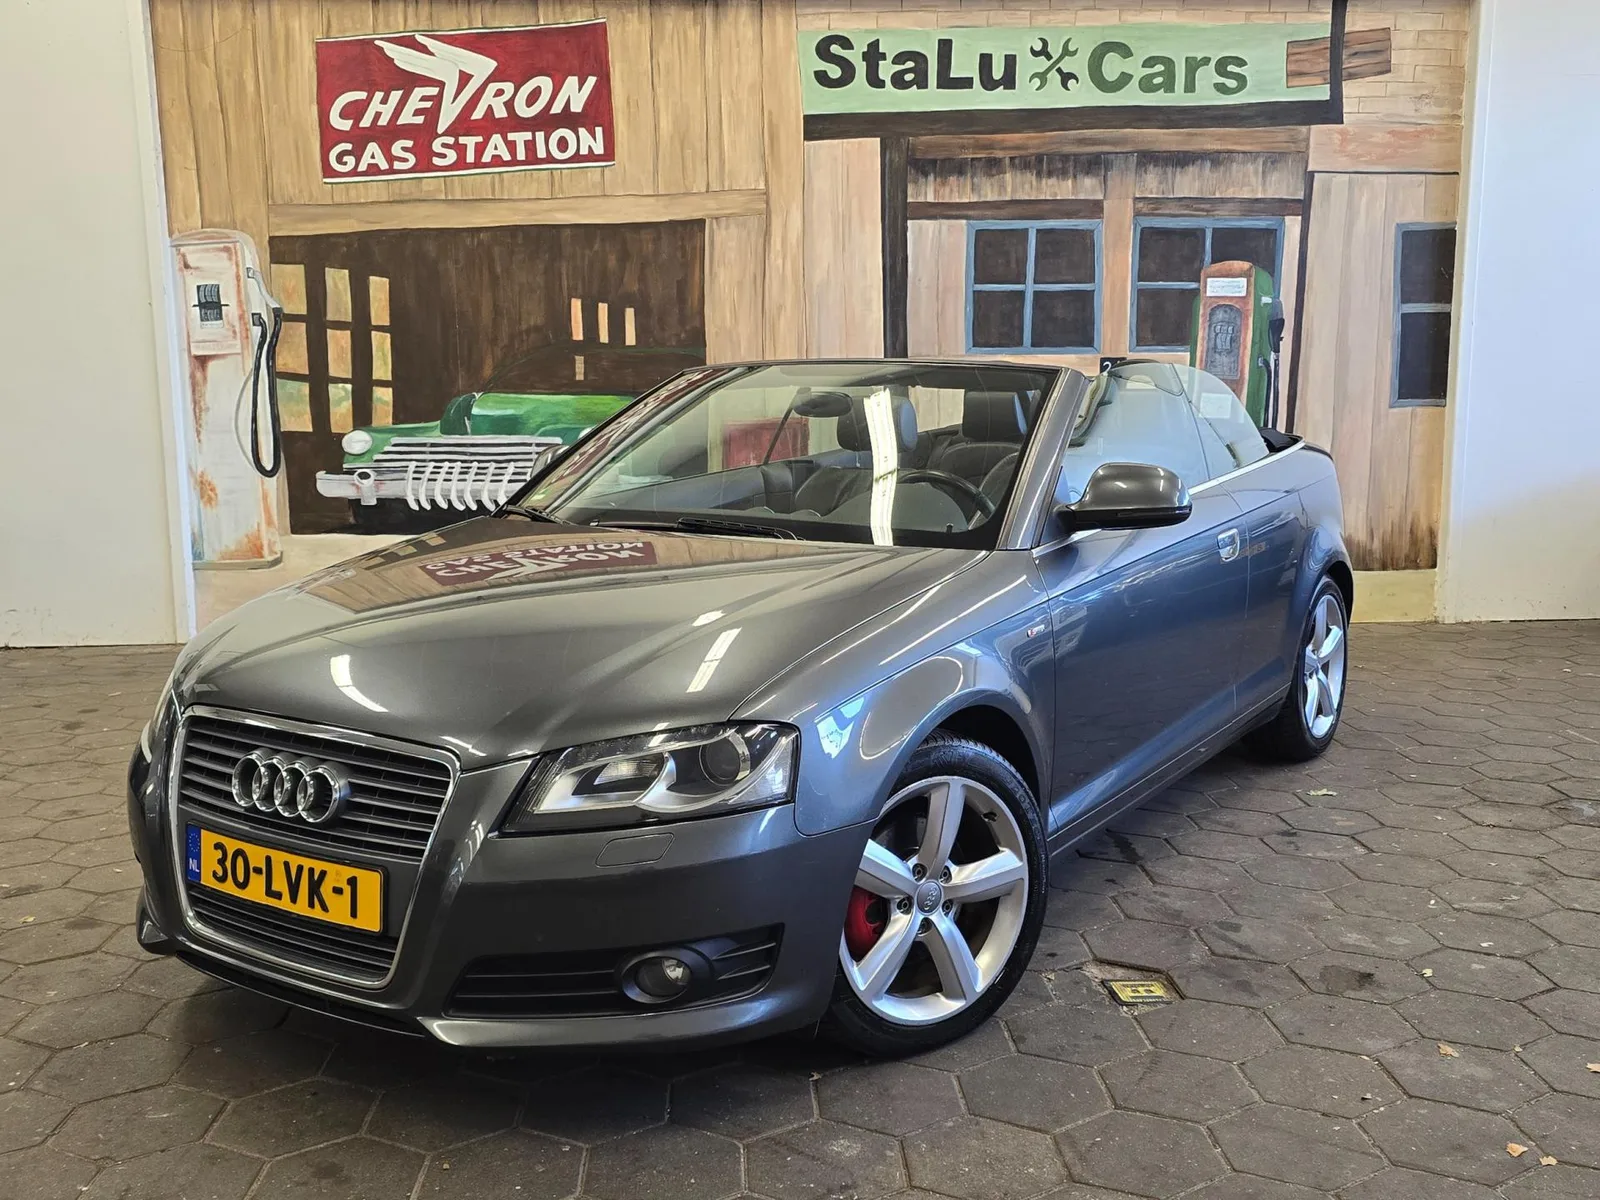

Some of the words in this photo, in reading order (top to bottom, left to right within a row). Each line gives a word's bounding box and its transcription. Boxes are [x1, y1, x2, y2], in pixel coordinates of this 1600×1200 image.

[329, 55, 597, 134] CHEVRON
[813, 34, 1017, 91] StaLu
[1087, 41, 1249, 95] Cars
[328, 140, 416, 173] GAS
[431, 126, 605, 167] STATION
[188, 857, 200, 873] NL
[212, 841, 358, 919] 30-LVK-1
